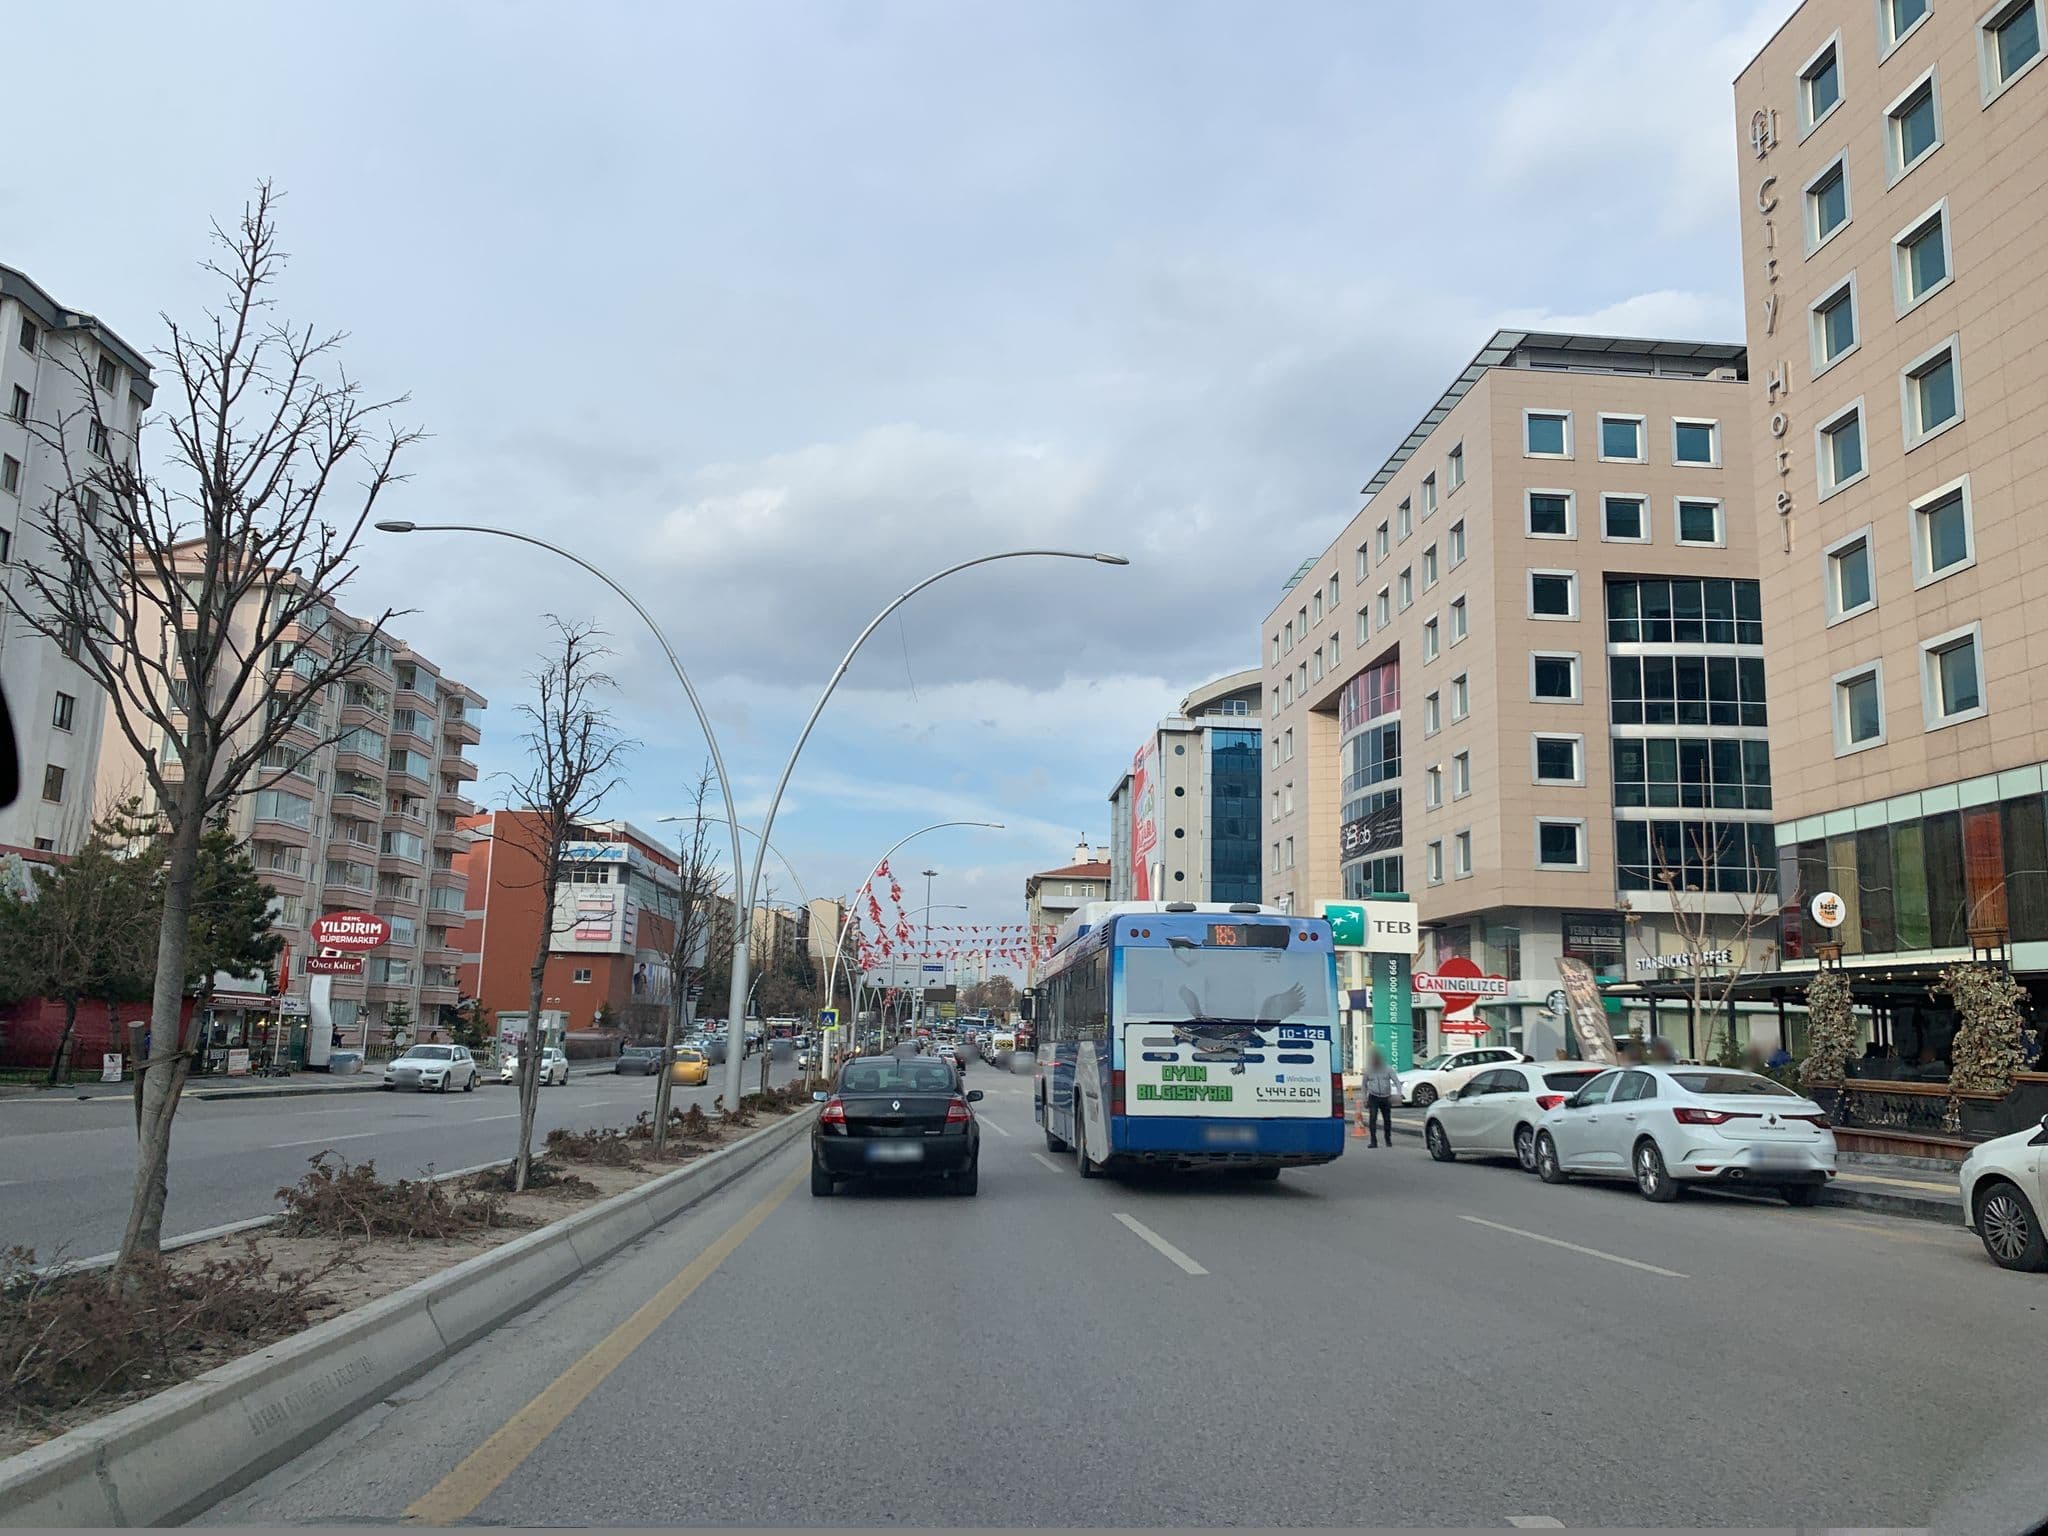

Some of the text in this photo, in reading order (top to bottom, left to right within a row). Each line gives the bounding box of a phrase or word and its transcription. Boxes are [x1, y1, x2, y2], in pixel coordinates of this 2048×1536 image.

[1767, 360, 1792, 555] Hotel
[320, 921, 382, 935] YILDIRIM
[1373, 920, 1411, 934] TEB
[320, 933, 379, 945] SÜPERMARKET
[1389, 959, 1397, 975] 666
[1635, 952, 1688, 971] STARBUCKS
[1389, 977, 1398, 993] 000
[1390, 1002, 1398, 1023] 0850
[1162, 1065, 1207, 1082] OYUN
[1265, 1087, 1321, 1097] 444 2 604
